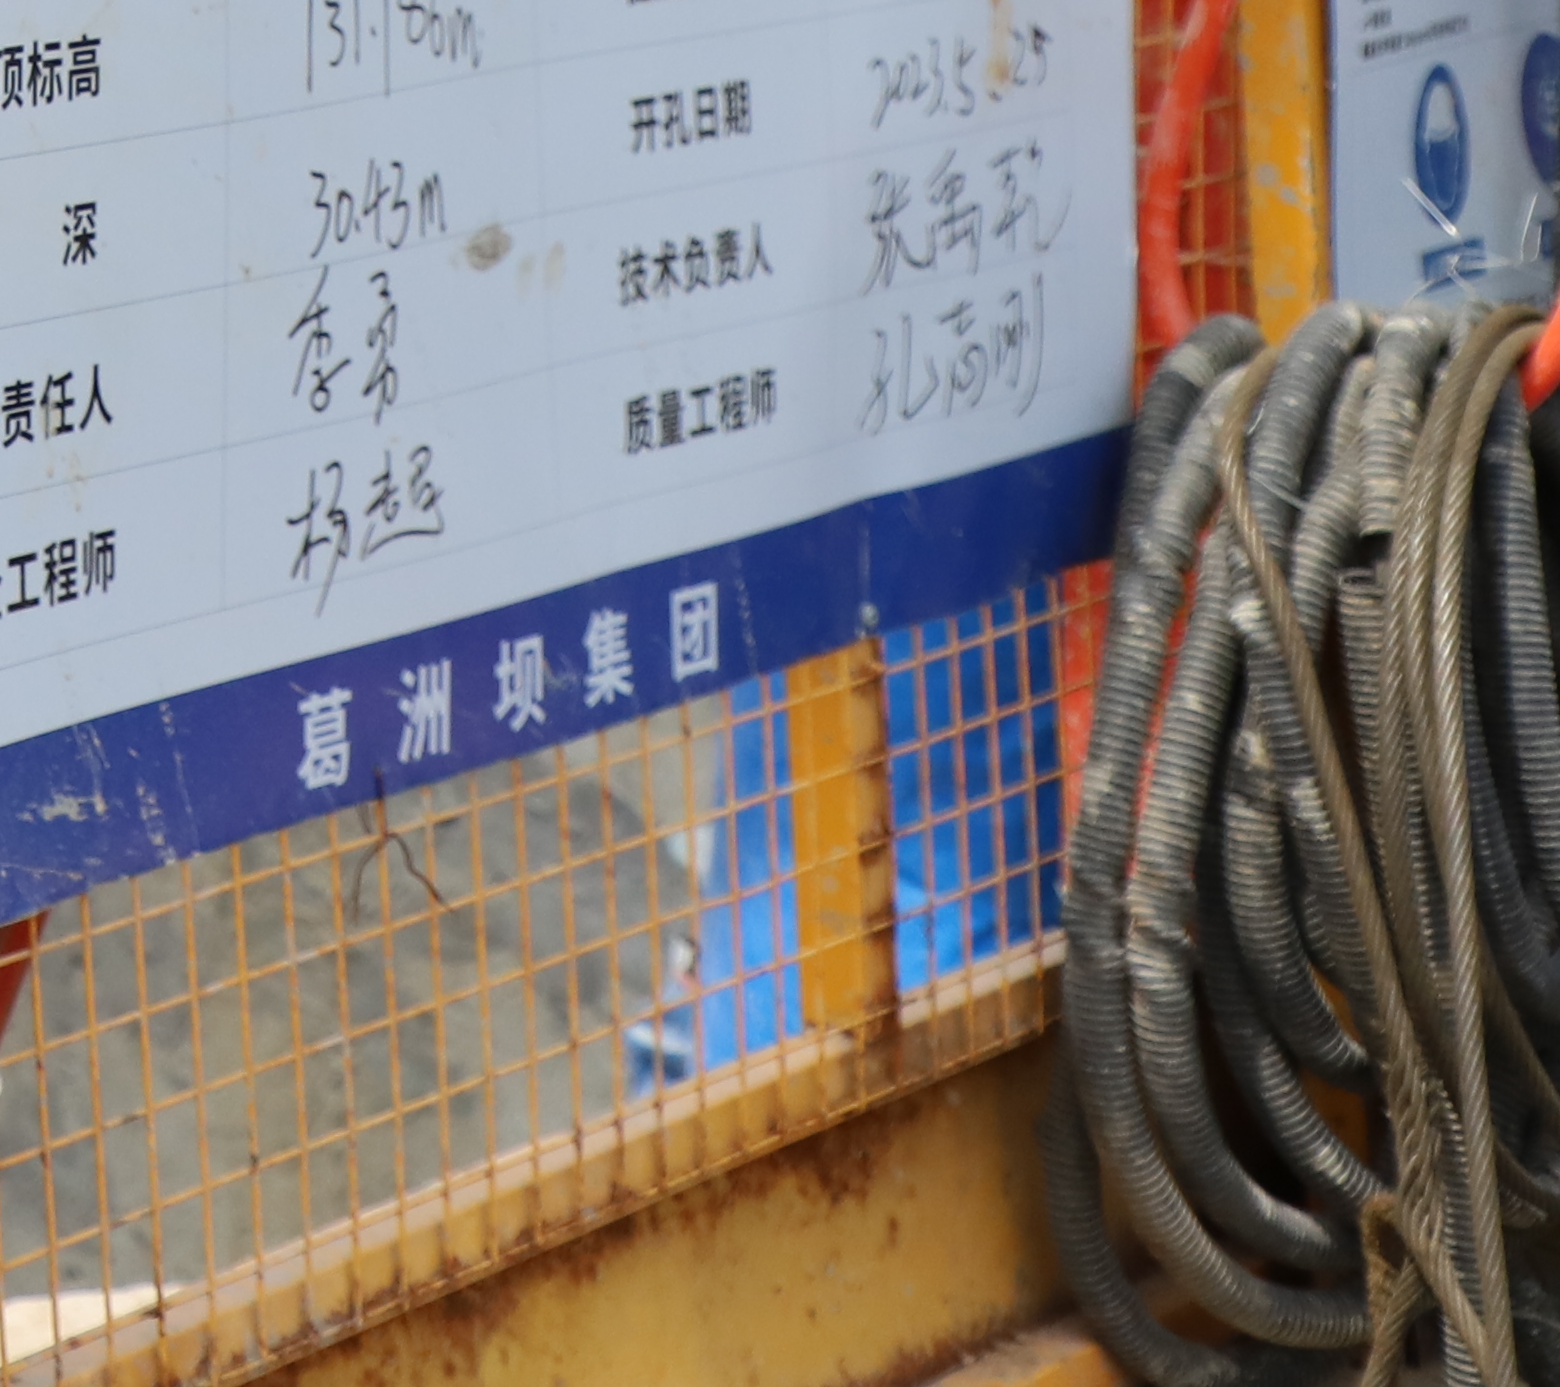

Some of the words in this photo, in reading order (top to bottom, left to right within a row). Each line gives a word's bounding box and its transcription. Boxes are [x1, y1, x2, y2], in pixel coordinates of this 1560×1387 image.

[629, 79, 751, 154] 开孔日期
[308, 158, 446, 259] 30.43m
[618, 222, 773, 307] 技术负责人
[624, 367, 778, 456] 质量工程师
[287, 444, 444, 617] 杨超
[295, 580, 720, 791] 葛洲坝集团
